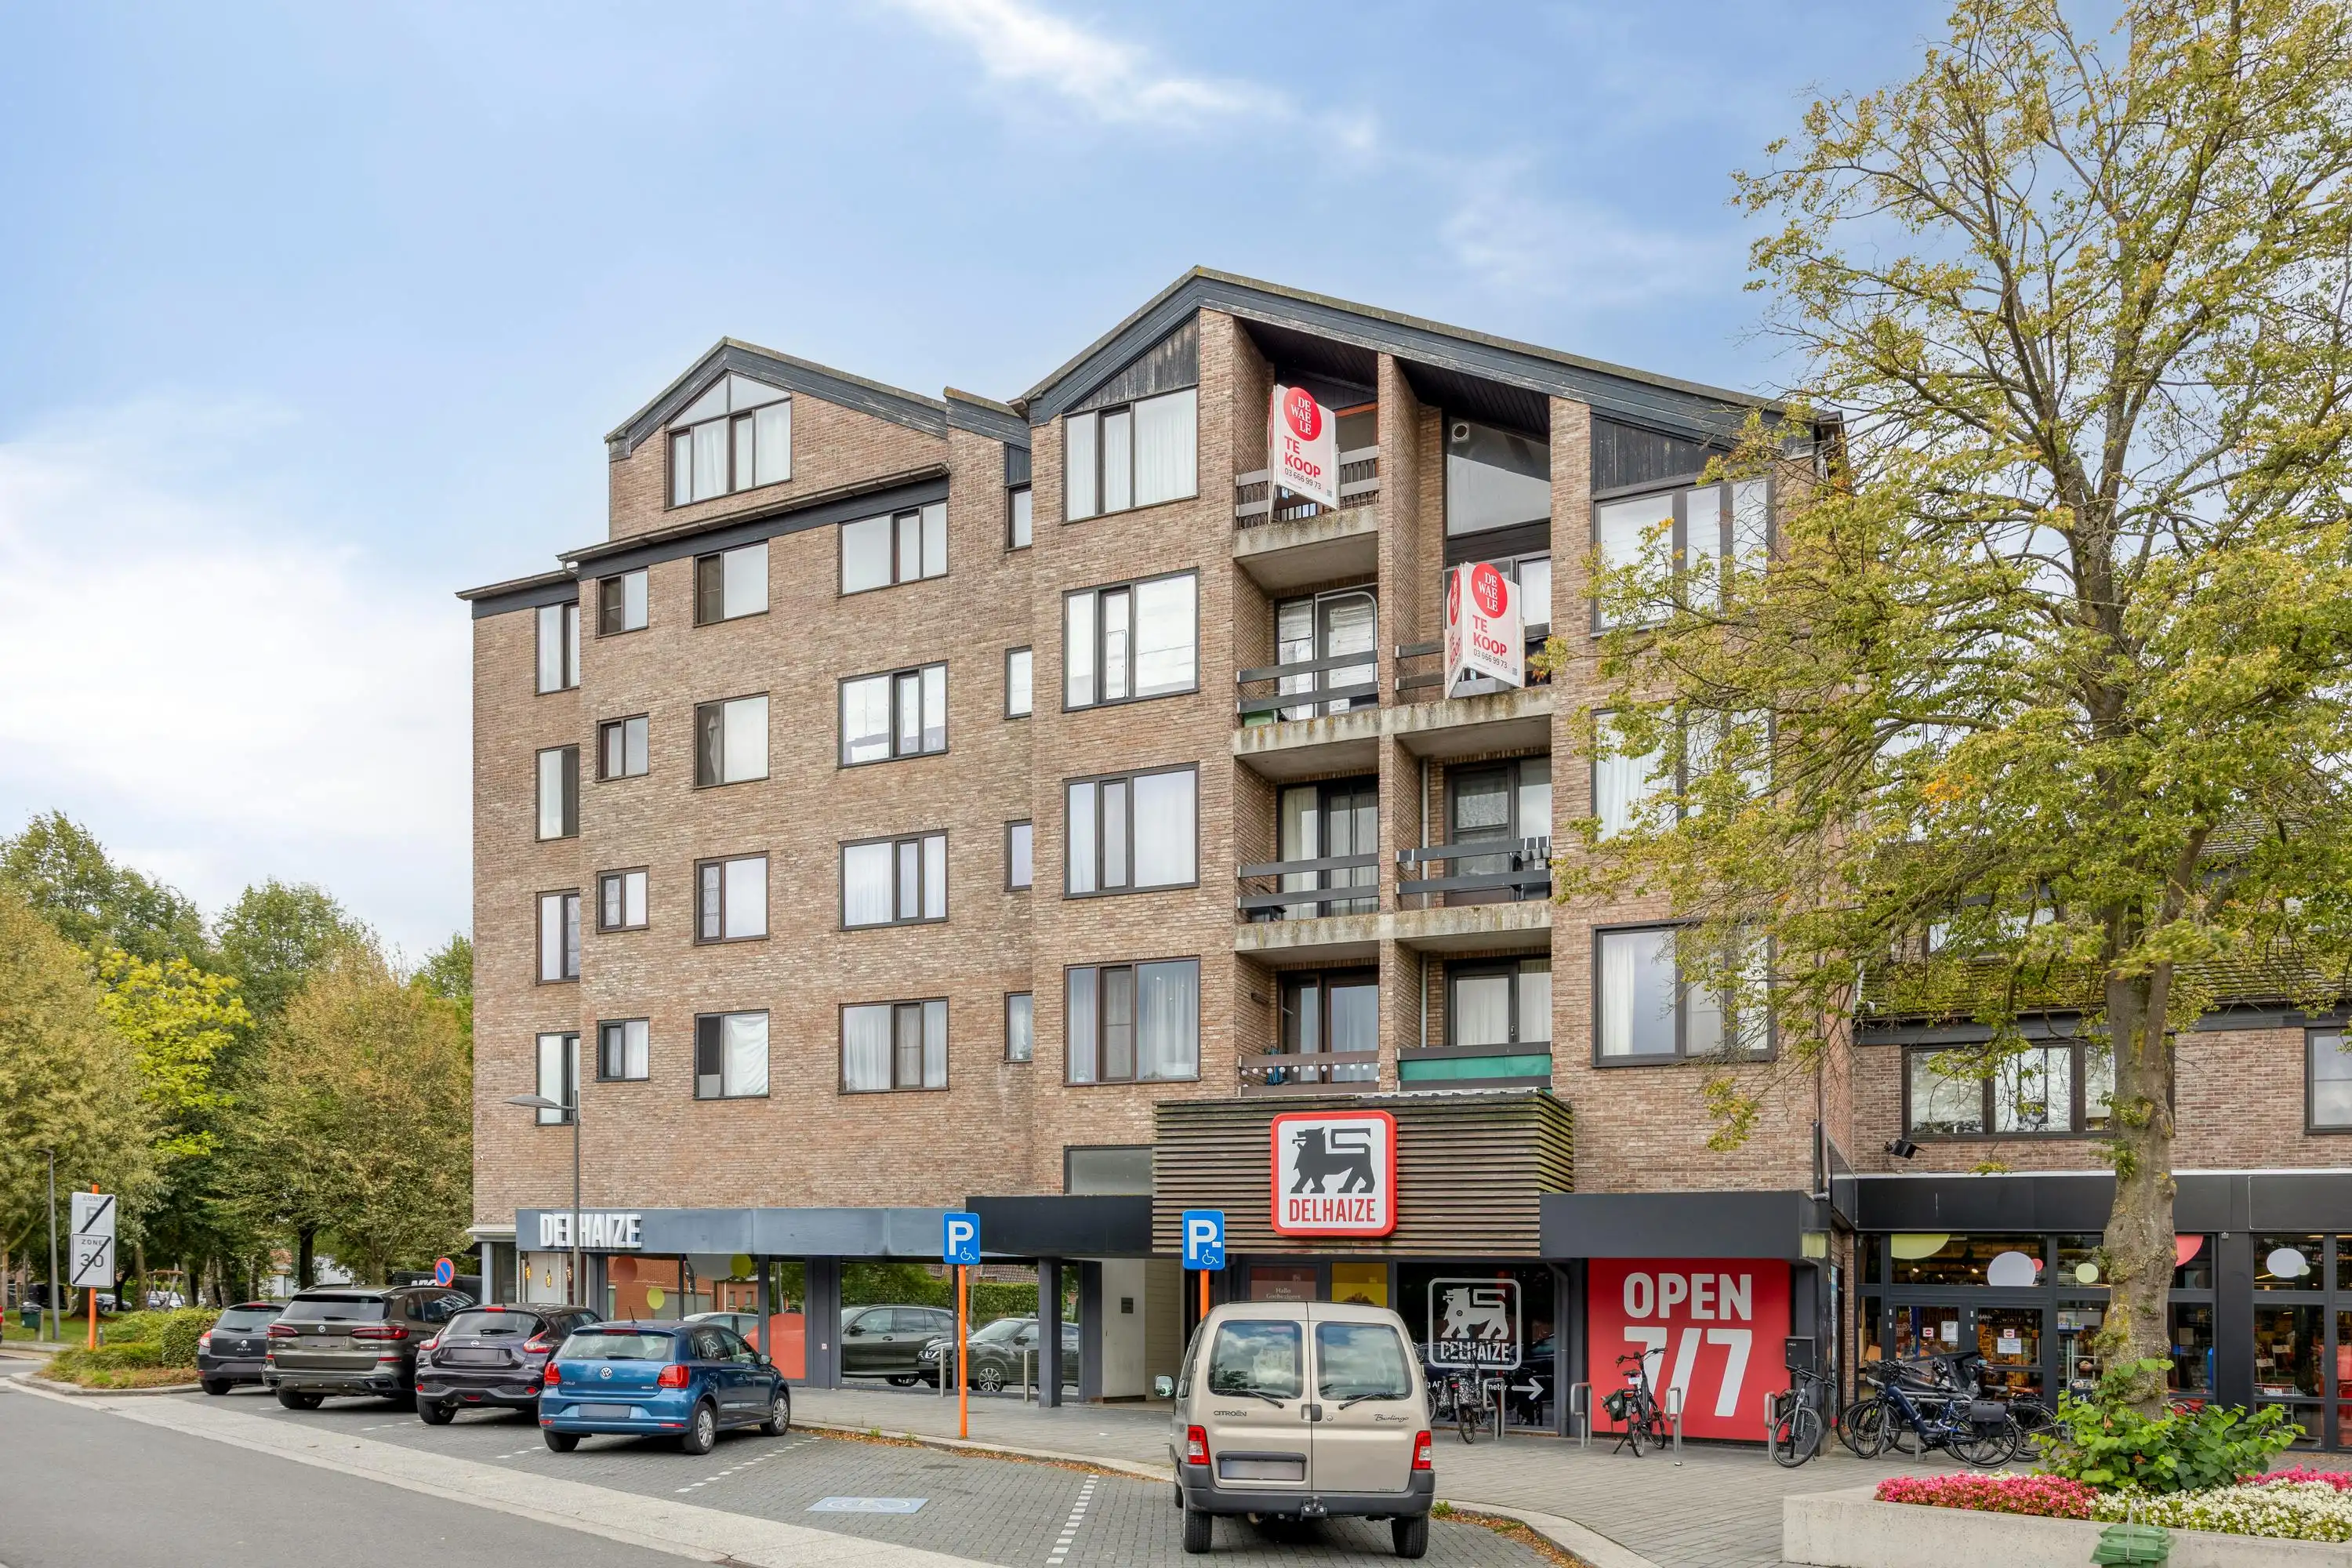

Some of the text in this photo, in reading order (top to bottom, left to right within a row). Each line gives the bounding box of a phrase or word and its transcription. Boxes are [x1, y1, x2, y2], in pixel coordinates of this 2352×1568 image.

[1298, 396, 1311, 412] DE
[1290, 404, 1311, 423] WAE
[1299, 420, 1311, 435] LE
[1284, 435, 1300, 454] TE
[1285, 452, 1320, 477] KOOP
[1285, 468, 1292, 477] 03
[1294, 472, 1305, 482] 666
[1306, 477, 1313, 486] 99
[1485, 572, 1497, 587] DE
[1478, 581, 1497, 599] WAE
[1486, 597, 1498, 612] LE
[1472, 615, 1487, 633] TE
[1474, 632, 1507, 656] KOOP
[1482, 652, 1492, 662] 666
[1501, 659, 1508, 669] 73
[1289, 1198, 1376, 1222] DELHAIZE
[948, 1221, 975, 1256] P
[1189, 1219, 1218, 1260] P
[80, 1253, 104, 1268] 30
[1624, 1272, 1751, 1321] OPEN
[1440, 1341, 1510, 1362] DELHAIZE
[1624, 1326, 1752, 1417] 7/7
[1374, 1414, 1410, 1423] Berlingo
